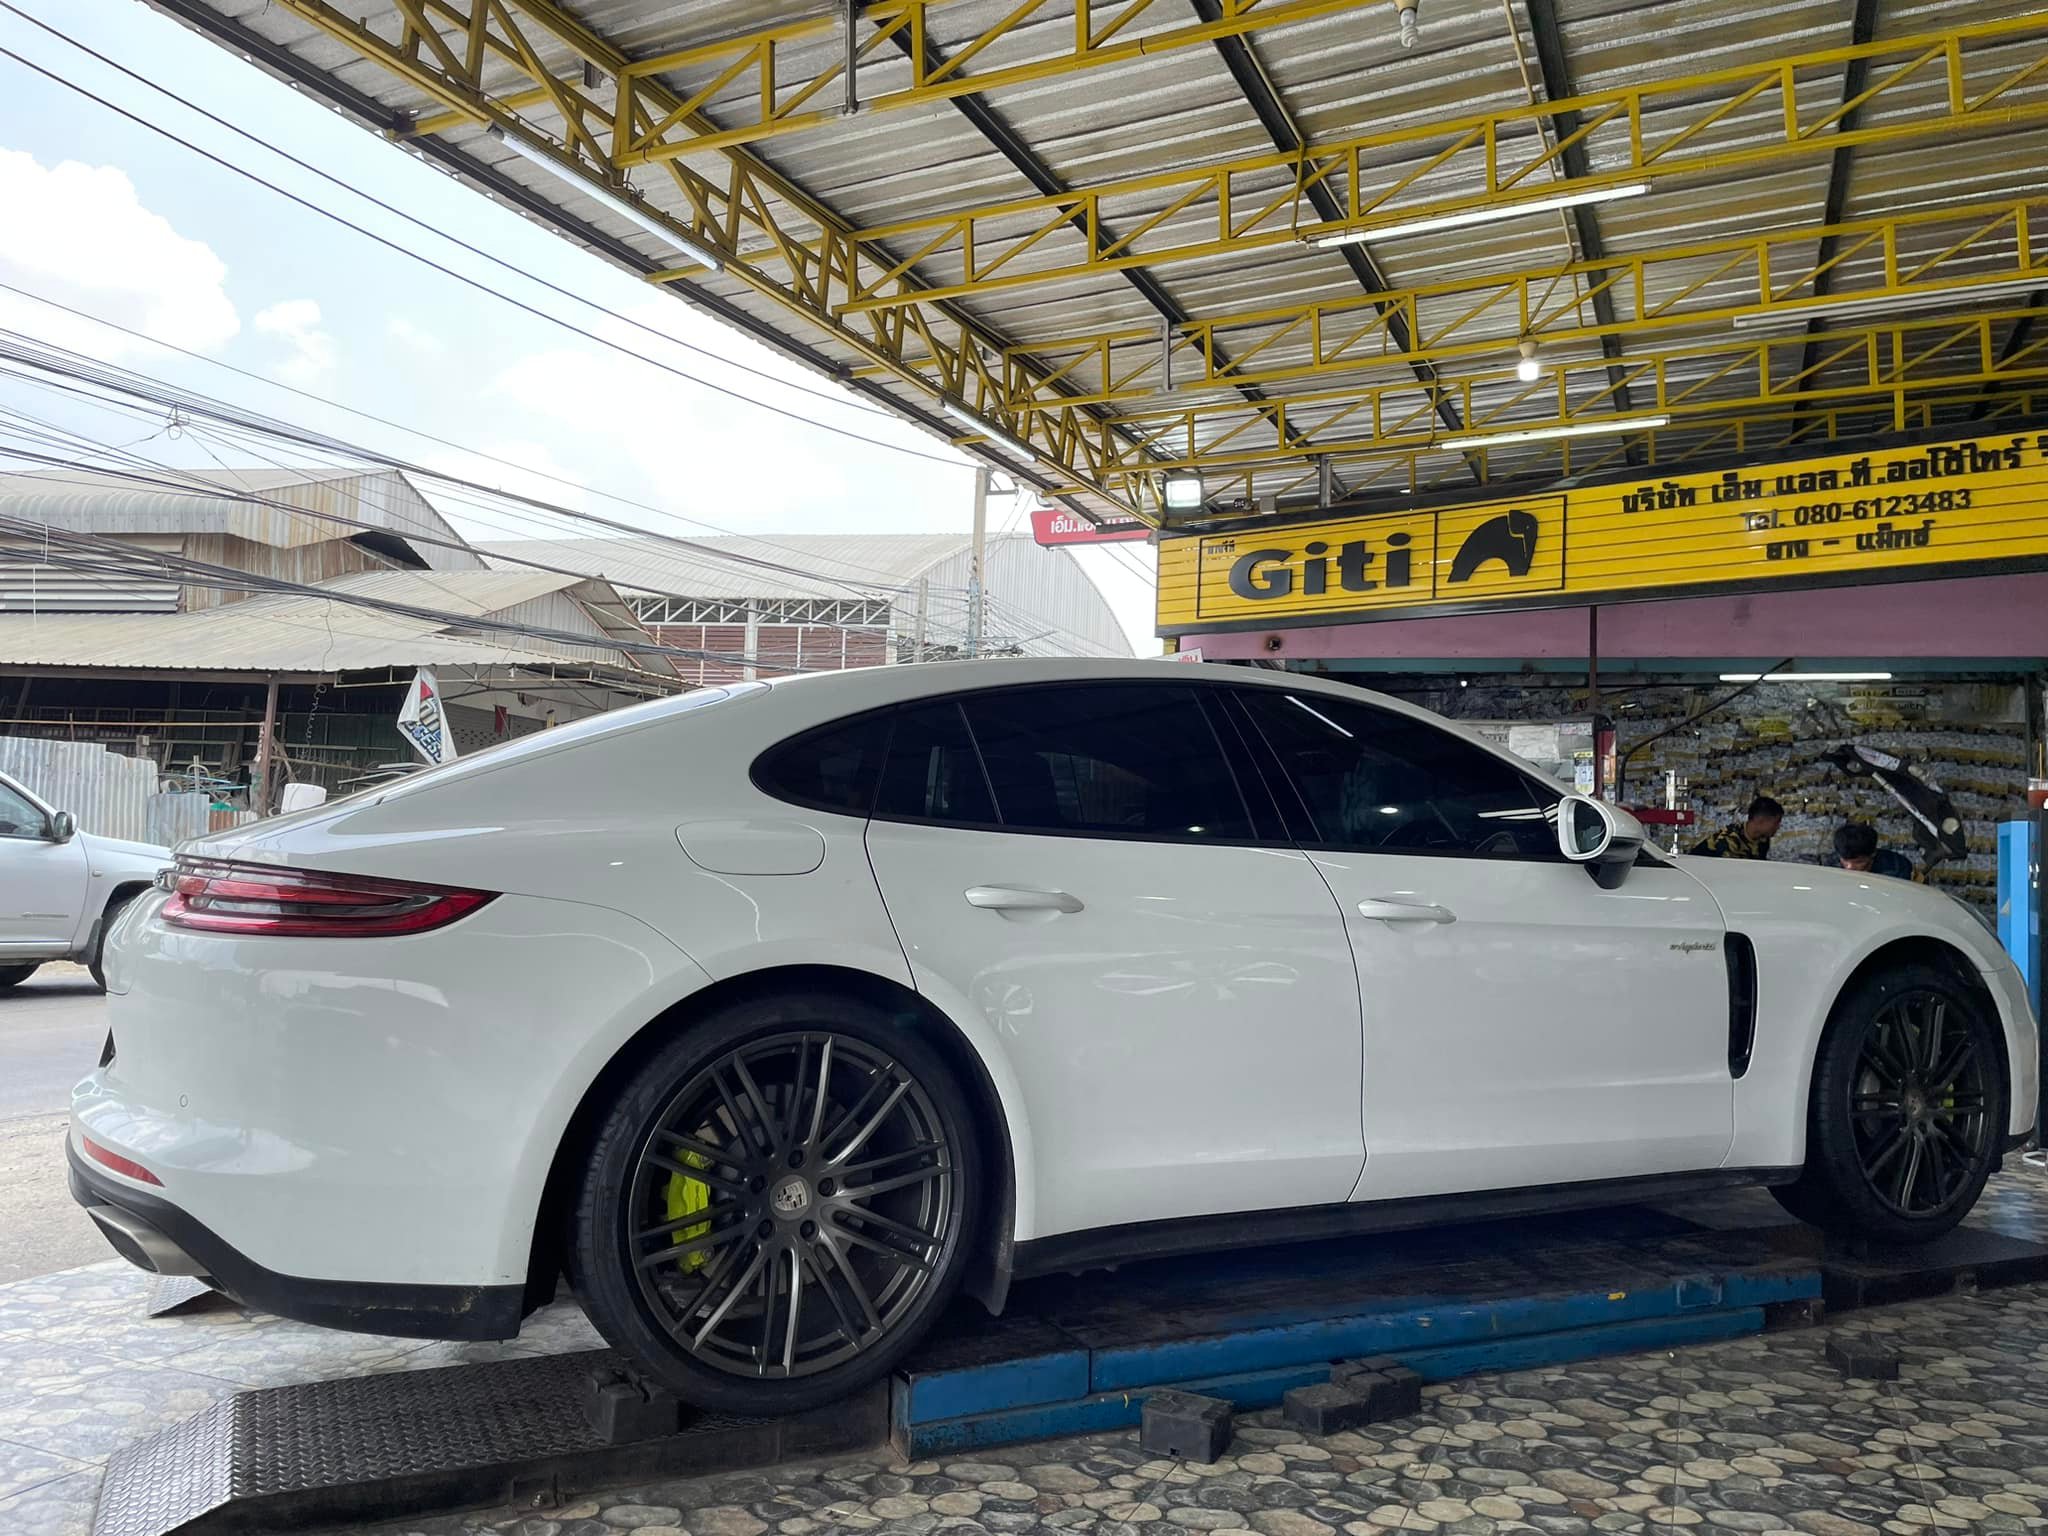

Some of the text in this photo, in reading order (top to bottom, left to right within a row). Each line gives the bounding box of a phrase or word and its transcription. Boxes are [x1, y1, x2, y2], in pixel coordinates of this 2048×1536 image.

[1622, 481, 1696, 514] บริษัท
[1741, 488, 1972, 532] Tel. 080-6123483
[1228, 532, 1412, 601] Giti
[1766, 540, 1809, 560] ยาง
